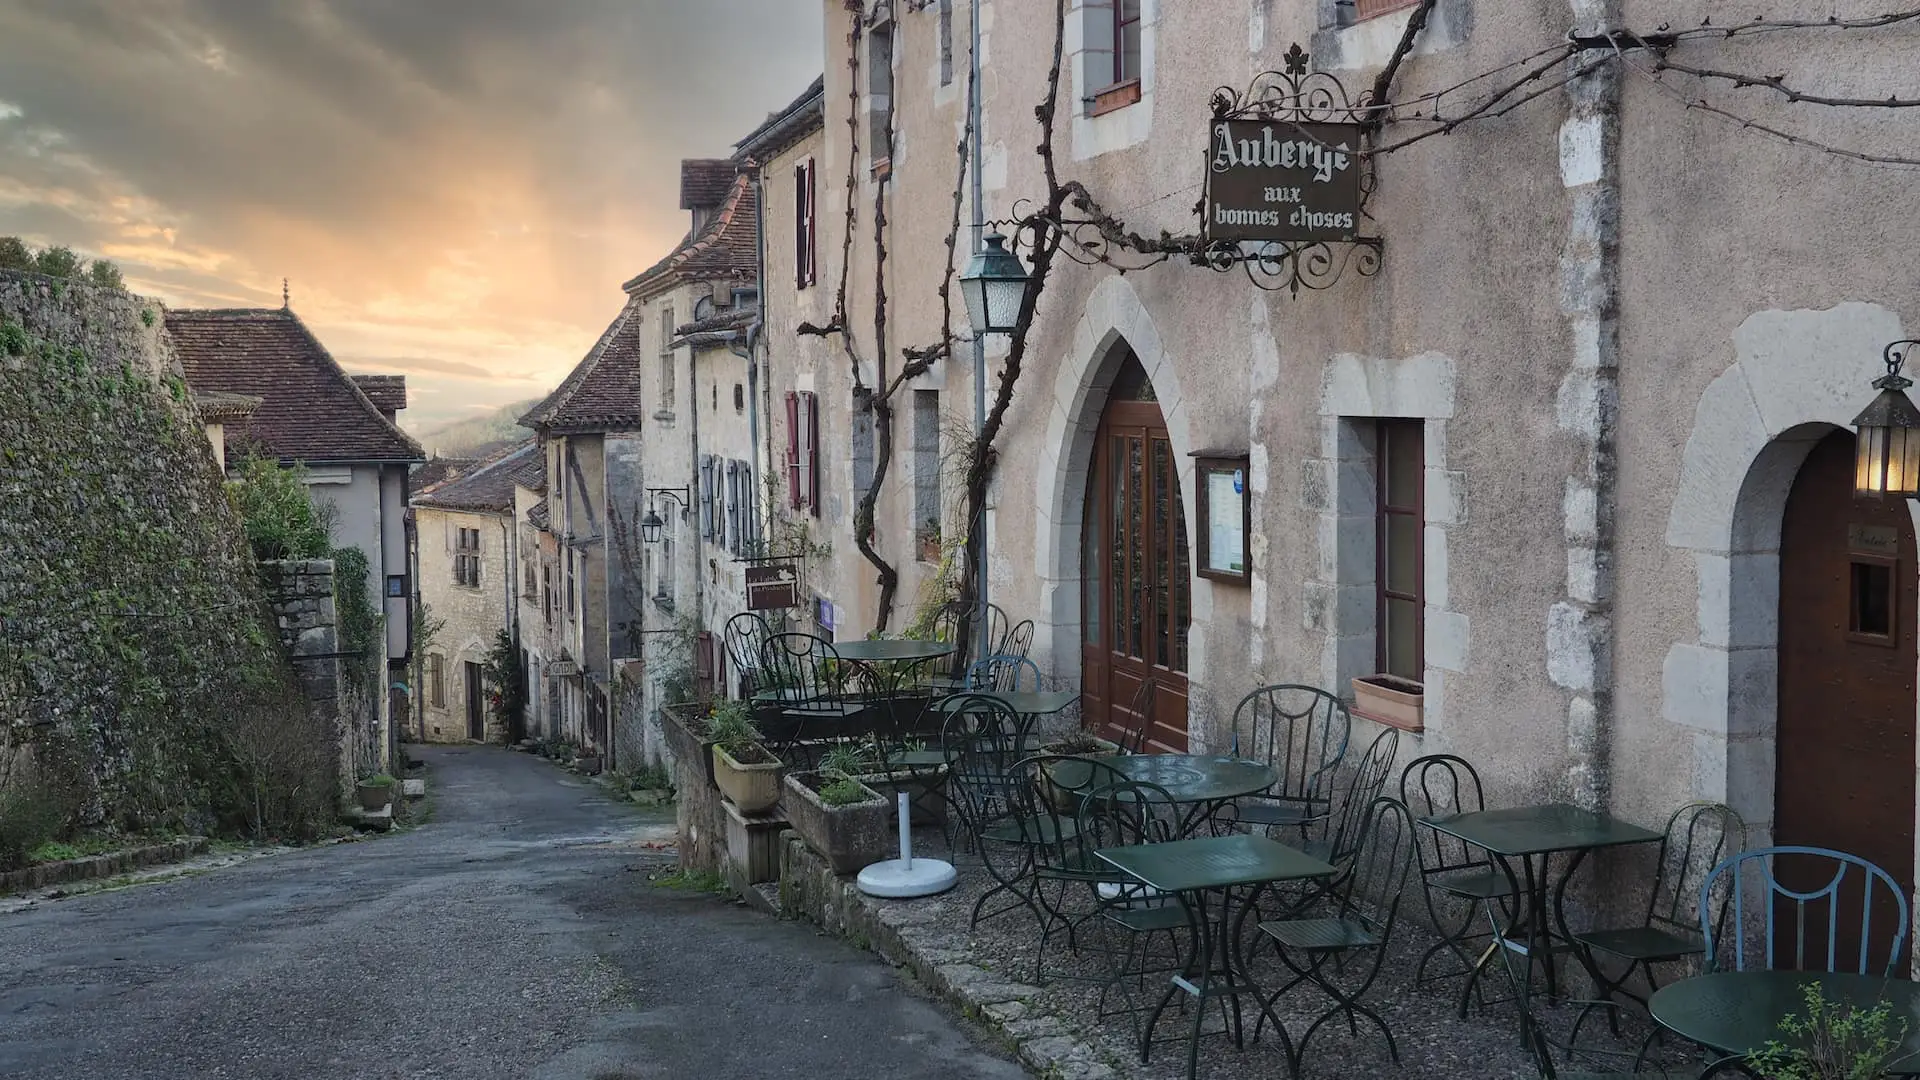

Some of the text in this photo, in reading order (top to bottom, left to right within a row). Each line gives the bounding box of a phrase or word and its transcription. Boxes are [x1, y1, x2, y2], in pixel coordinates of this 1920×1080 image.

[1212, 121, 1350, 182] Auberge
[1264, 186, 1302, 203] aux
[1215, 203, 1353, 232] bonnes choses
